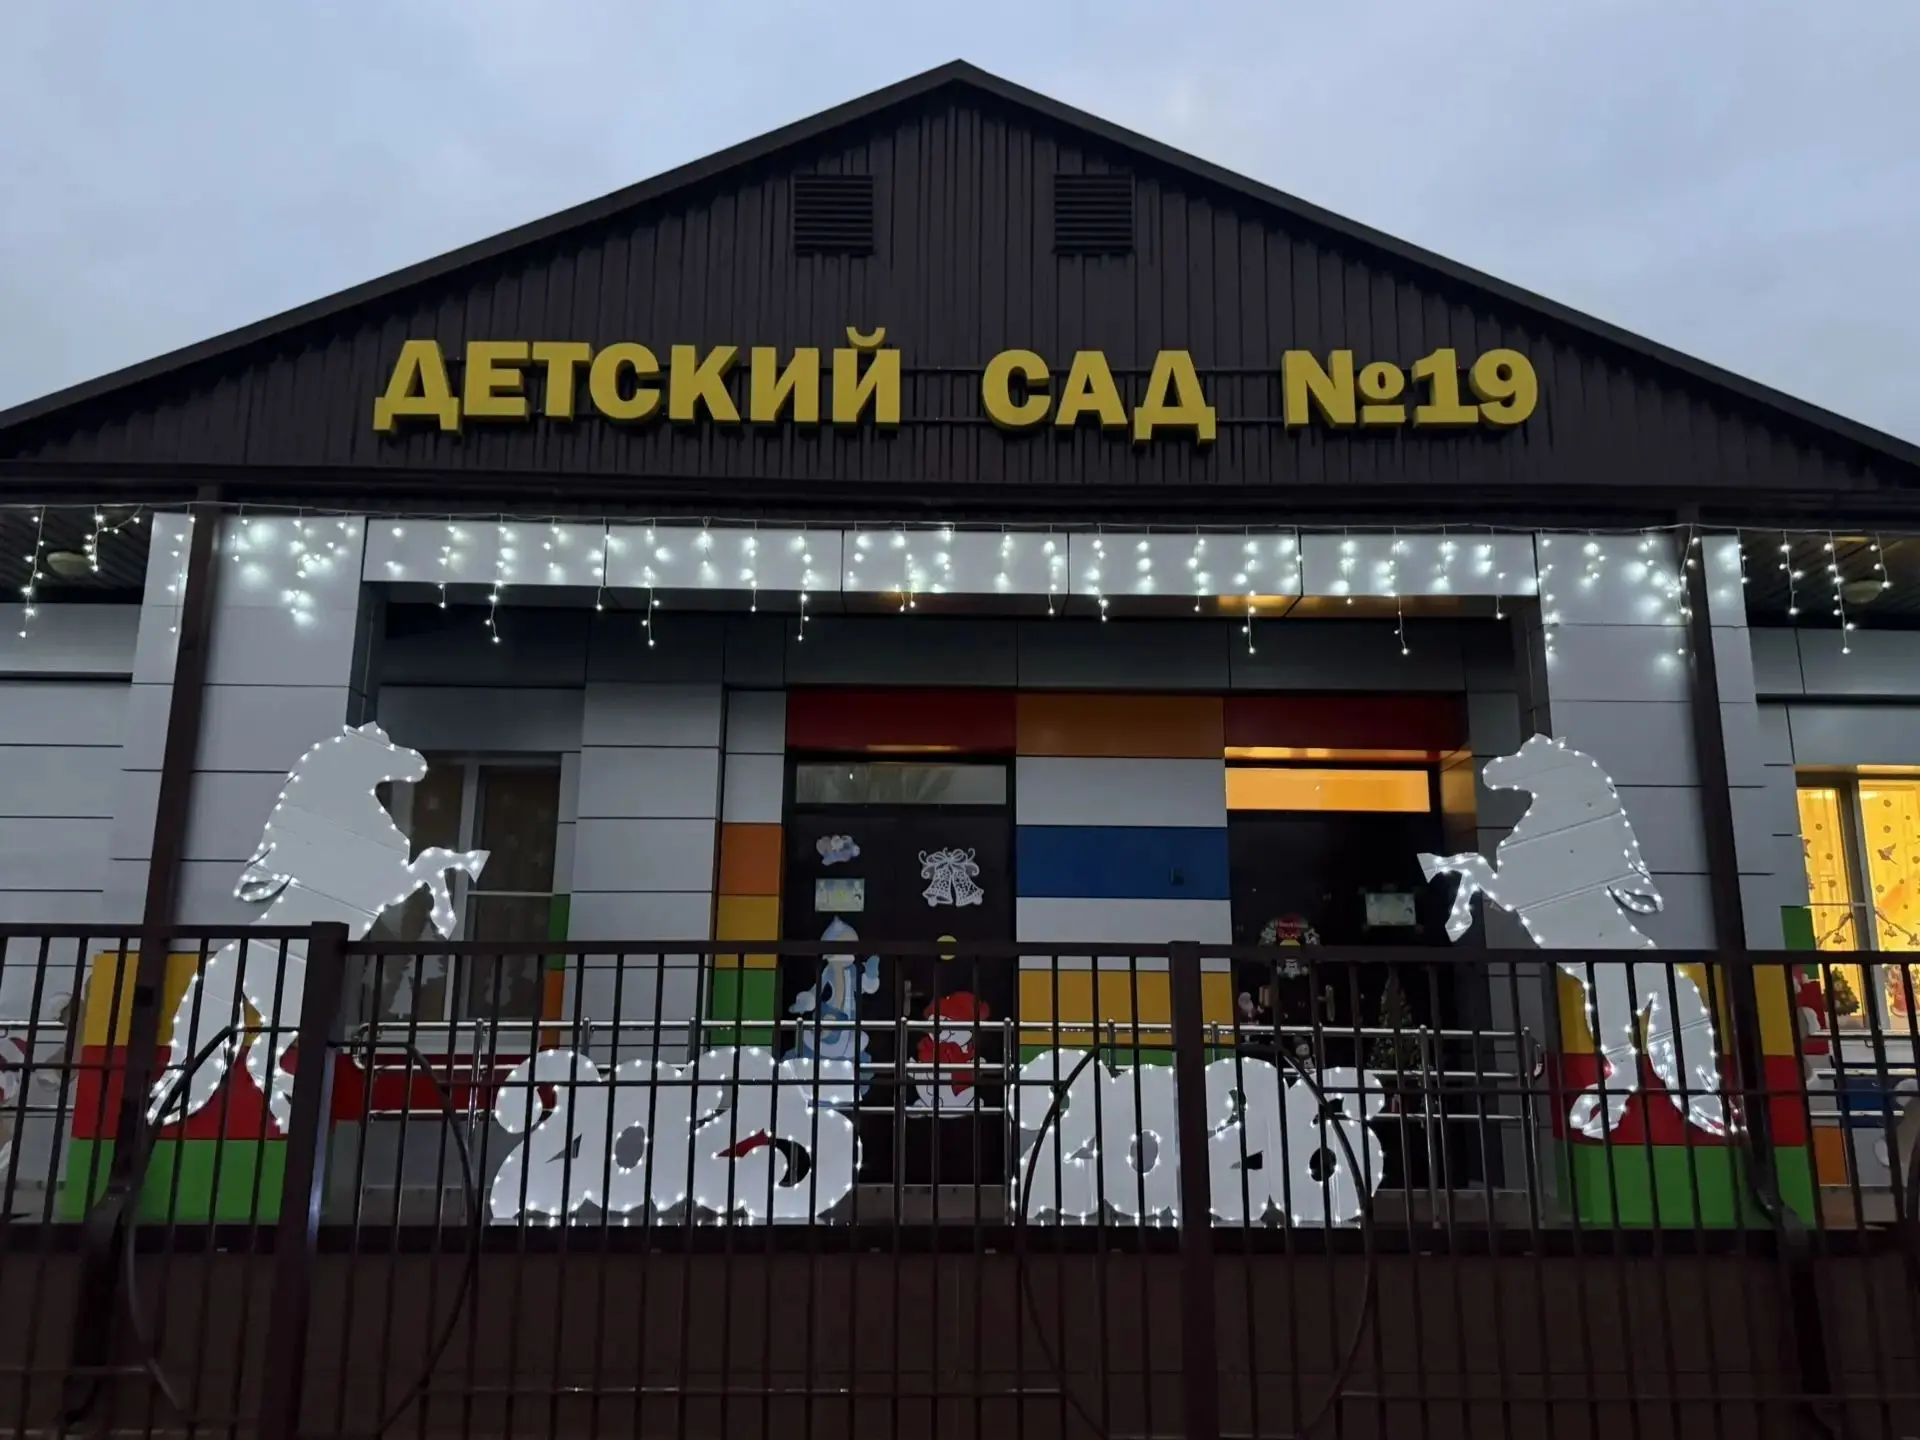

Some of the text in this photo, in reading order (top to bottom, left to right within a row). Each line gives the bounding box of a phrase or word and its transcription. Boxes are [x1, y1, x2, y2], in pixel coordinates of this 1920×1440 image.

[373, 326, 1538, 443] ДЕТСКИЙ САД №19
[490, 1046, 862, 1221] 2025
[1008, 1048, 1384, 1222] 2026
